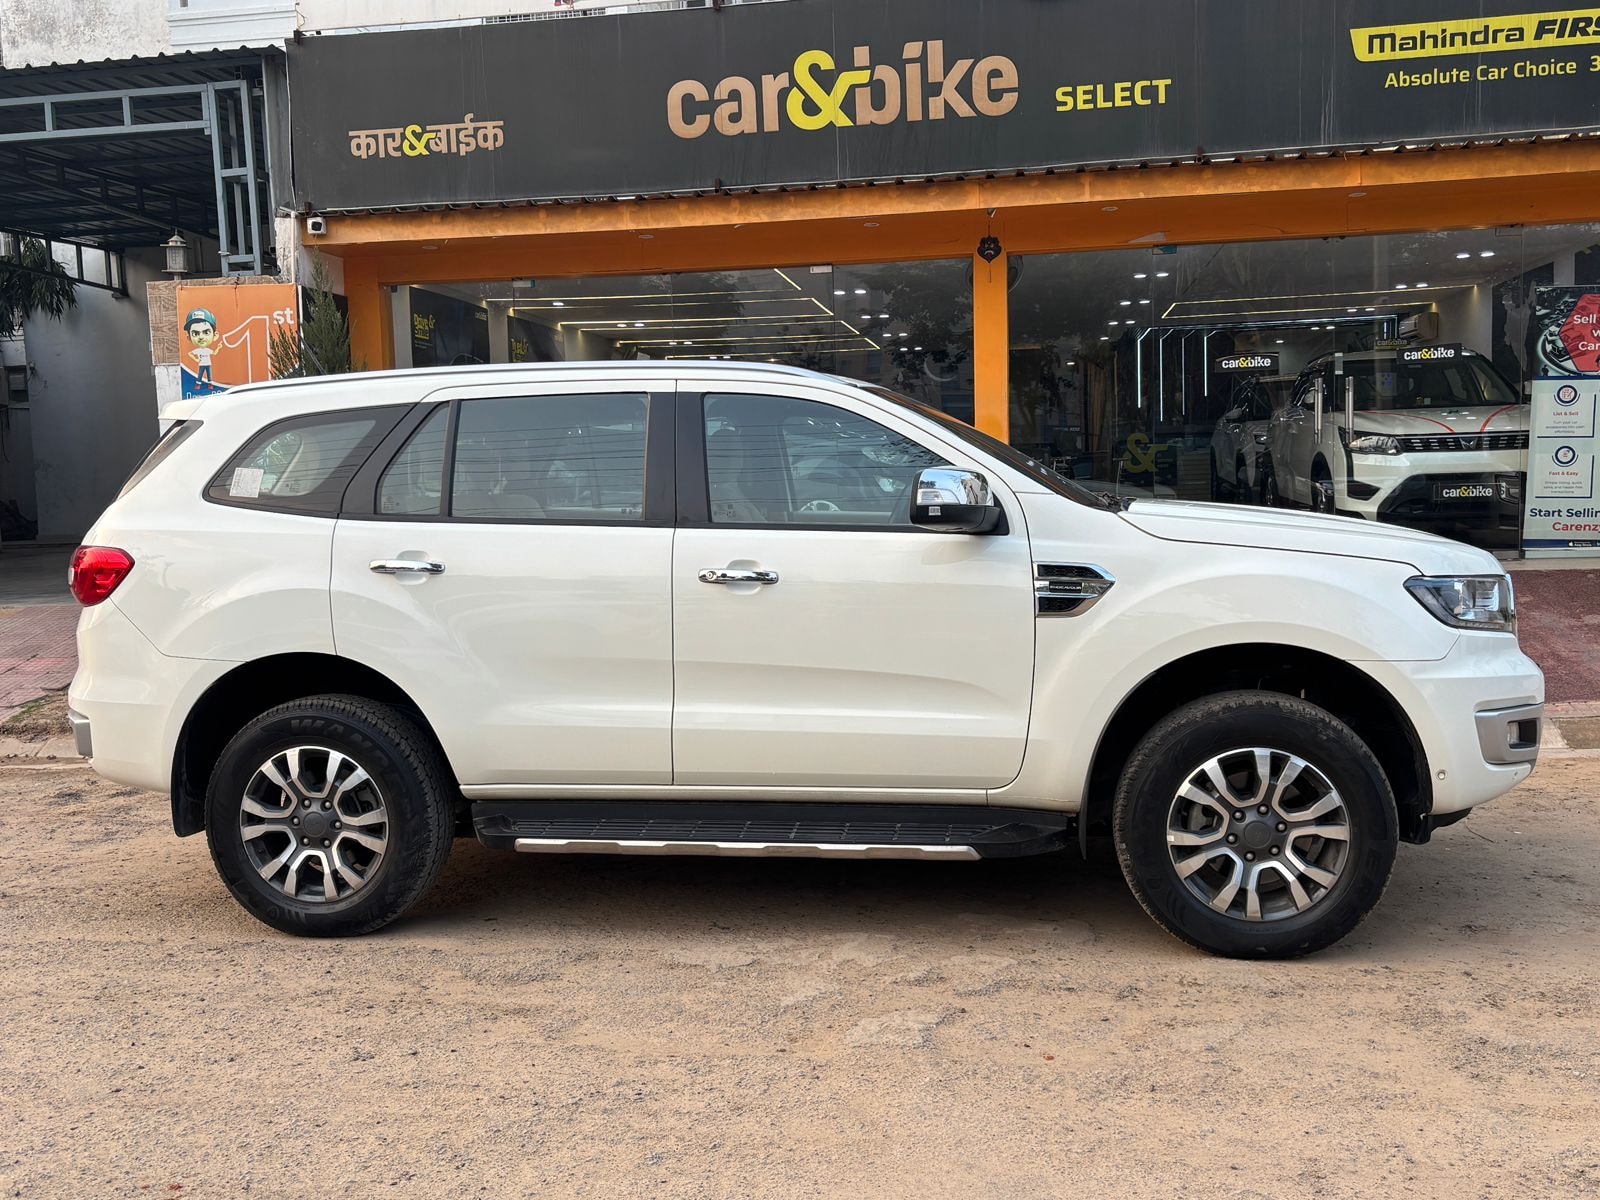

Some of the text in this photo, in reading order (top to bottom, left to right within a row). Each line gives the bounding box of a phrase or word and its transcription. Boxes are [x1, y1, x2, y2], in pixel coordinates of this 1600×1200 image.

[1367, 24, 1525, 55] Mahindra
[1384, 67, 1470, 89] Absolute
[1476, 64, 1508, 81] Car
[1513, 58, 1577, 78] Choice
[667, 39, 1172, 139] car&bike SELECT
[348, 112, 505, 160] कार&बाईक
[1573, 313, 1597, 324] Sell
[1403, 346, 1455, 360] car&bike
[1221, 356, 1272, 369] car&bike
[1442, 485, 1493, 498] car&bike
[1529, 507, 1563, 518] Start
[1552, 521, 1600, 532] Carenz
